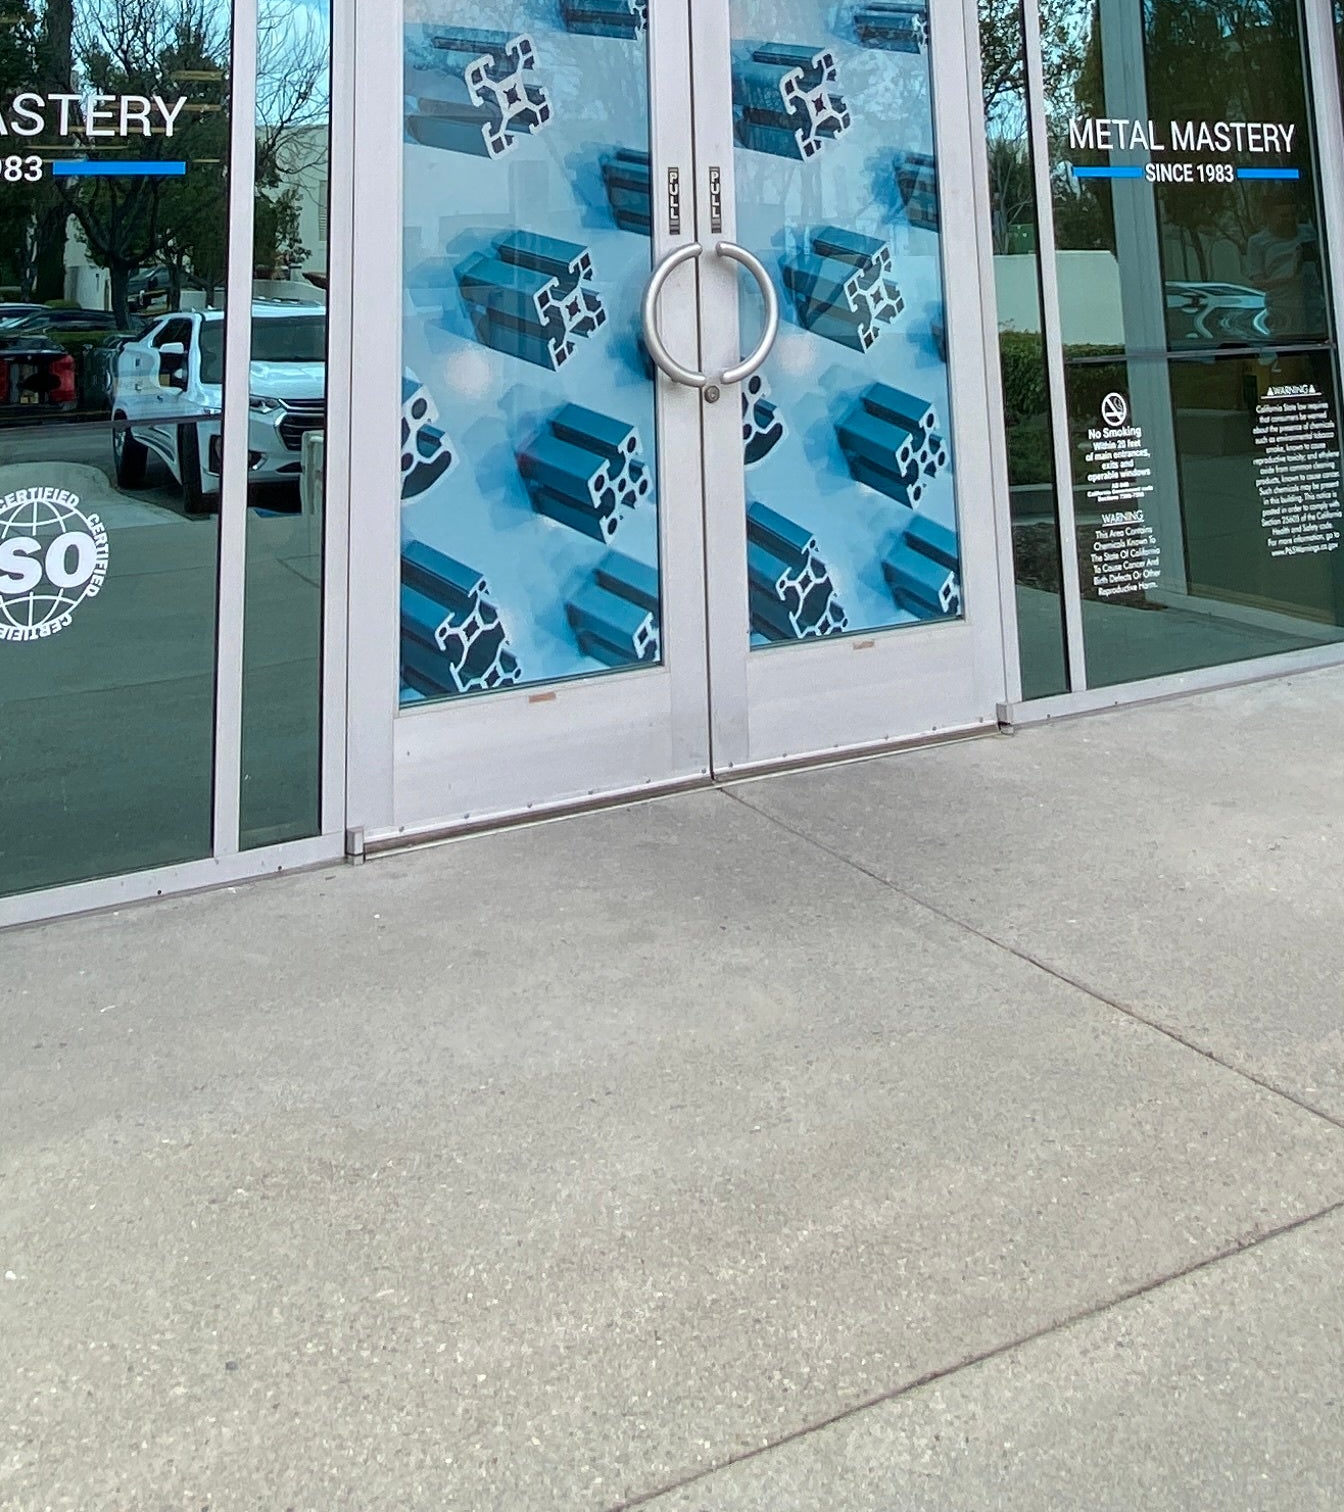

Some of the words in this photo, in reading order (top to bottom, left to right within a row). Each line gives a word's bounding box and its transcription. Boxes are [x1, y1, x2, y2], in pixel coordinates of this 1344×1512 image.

[1069, 118, 1165, 151] METAL
[1171, 121, 1295, 153] MASTERY
[1145, 164, 1194, 182] SINCE
[1197, 164, 1234, 183] 1983
[670, 172, 678, 219] PULL
[711, 172, 720, 217] PULL
[1273, 384, 1308, 394] WARNING
[1088, 429, 1101, 439] No
[1103, 426, 1141, 438] Smoking
[1102, 510, 1143, 523] WARNING
[86, 513, 109, 598] CERTIFIED
